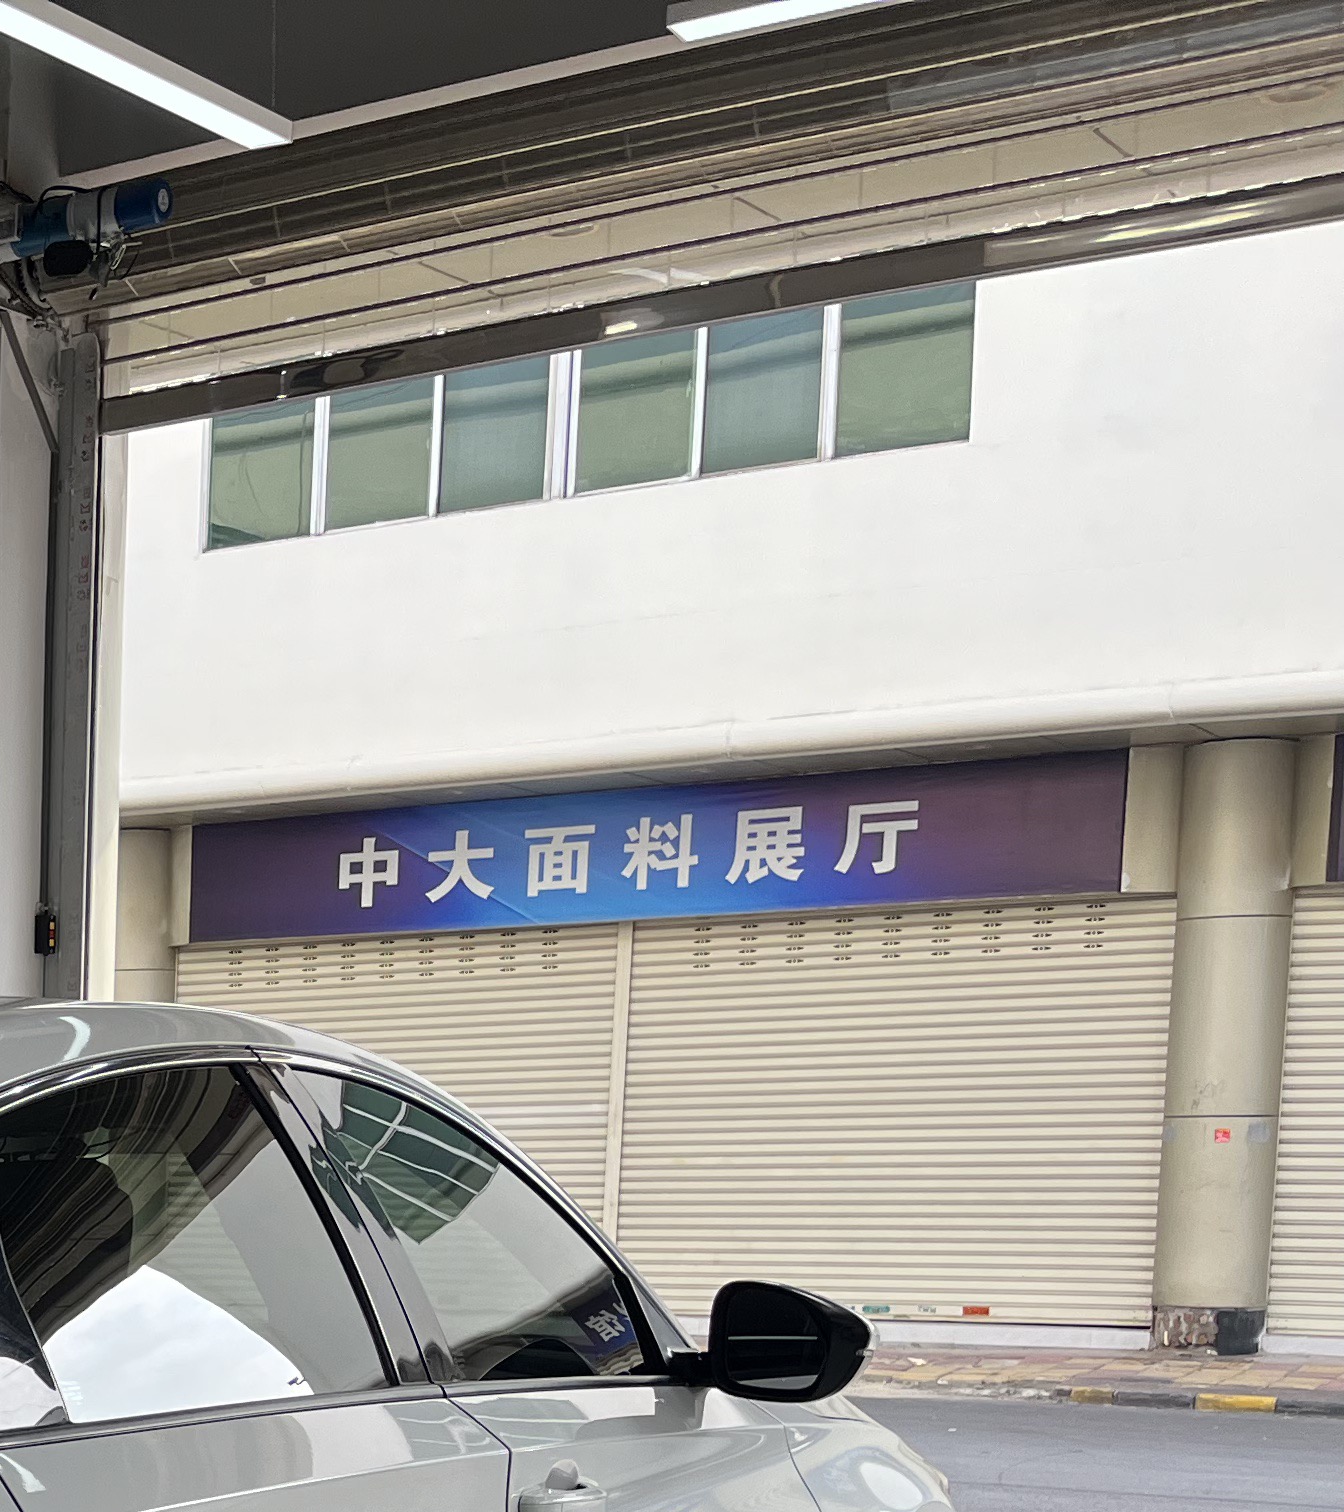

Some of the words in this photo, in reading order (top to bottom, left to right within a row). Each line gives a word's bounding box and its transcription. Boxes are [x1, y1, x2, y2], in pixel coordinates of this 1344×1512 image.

[337, 799, 921, 909] 中大面料展厅
